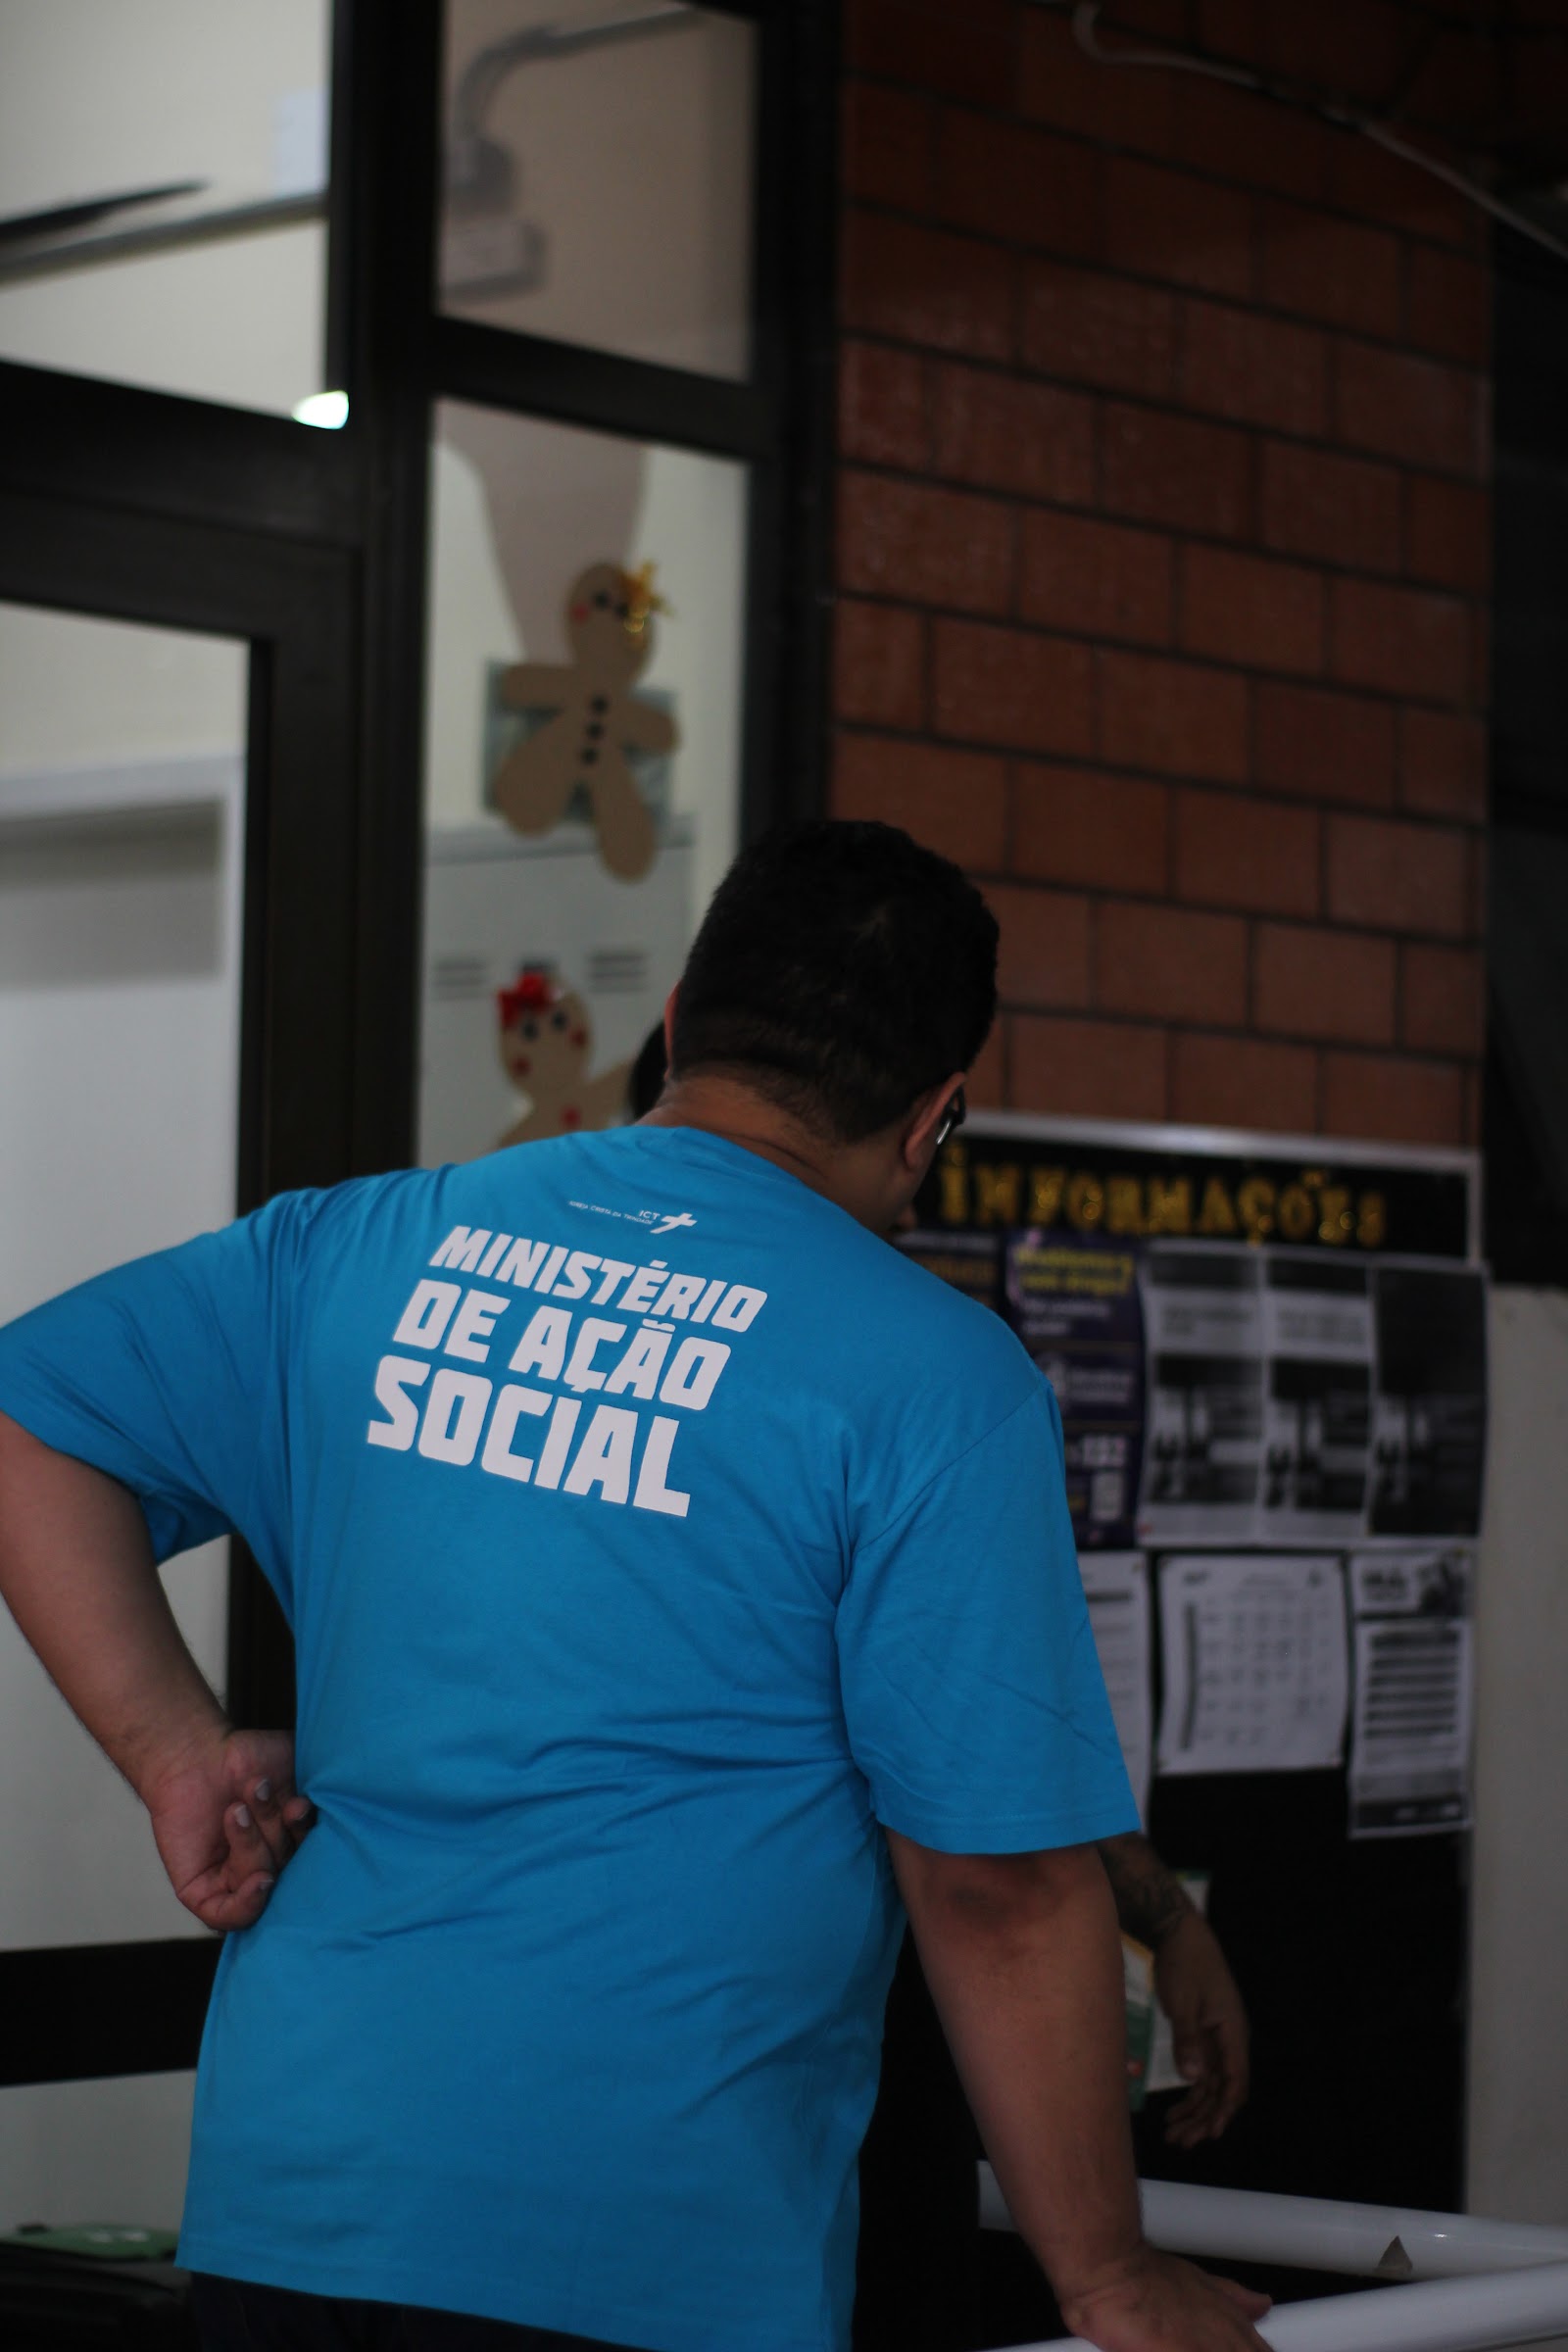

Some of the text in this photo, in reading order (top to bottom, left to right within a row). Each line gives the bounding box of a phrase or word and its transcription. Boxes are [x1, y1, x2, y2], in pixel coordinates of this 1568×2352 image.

[623, 1213, 655, 1225] TRINDADE
[639, 1210, 661, 1221] ICT
[429, 1225, 768, 1333] MINISTÉRIO
[393, 1279, 731, 1411] DE AÇÃO
[368, 1354, 691, 1518] SOCIAL
